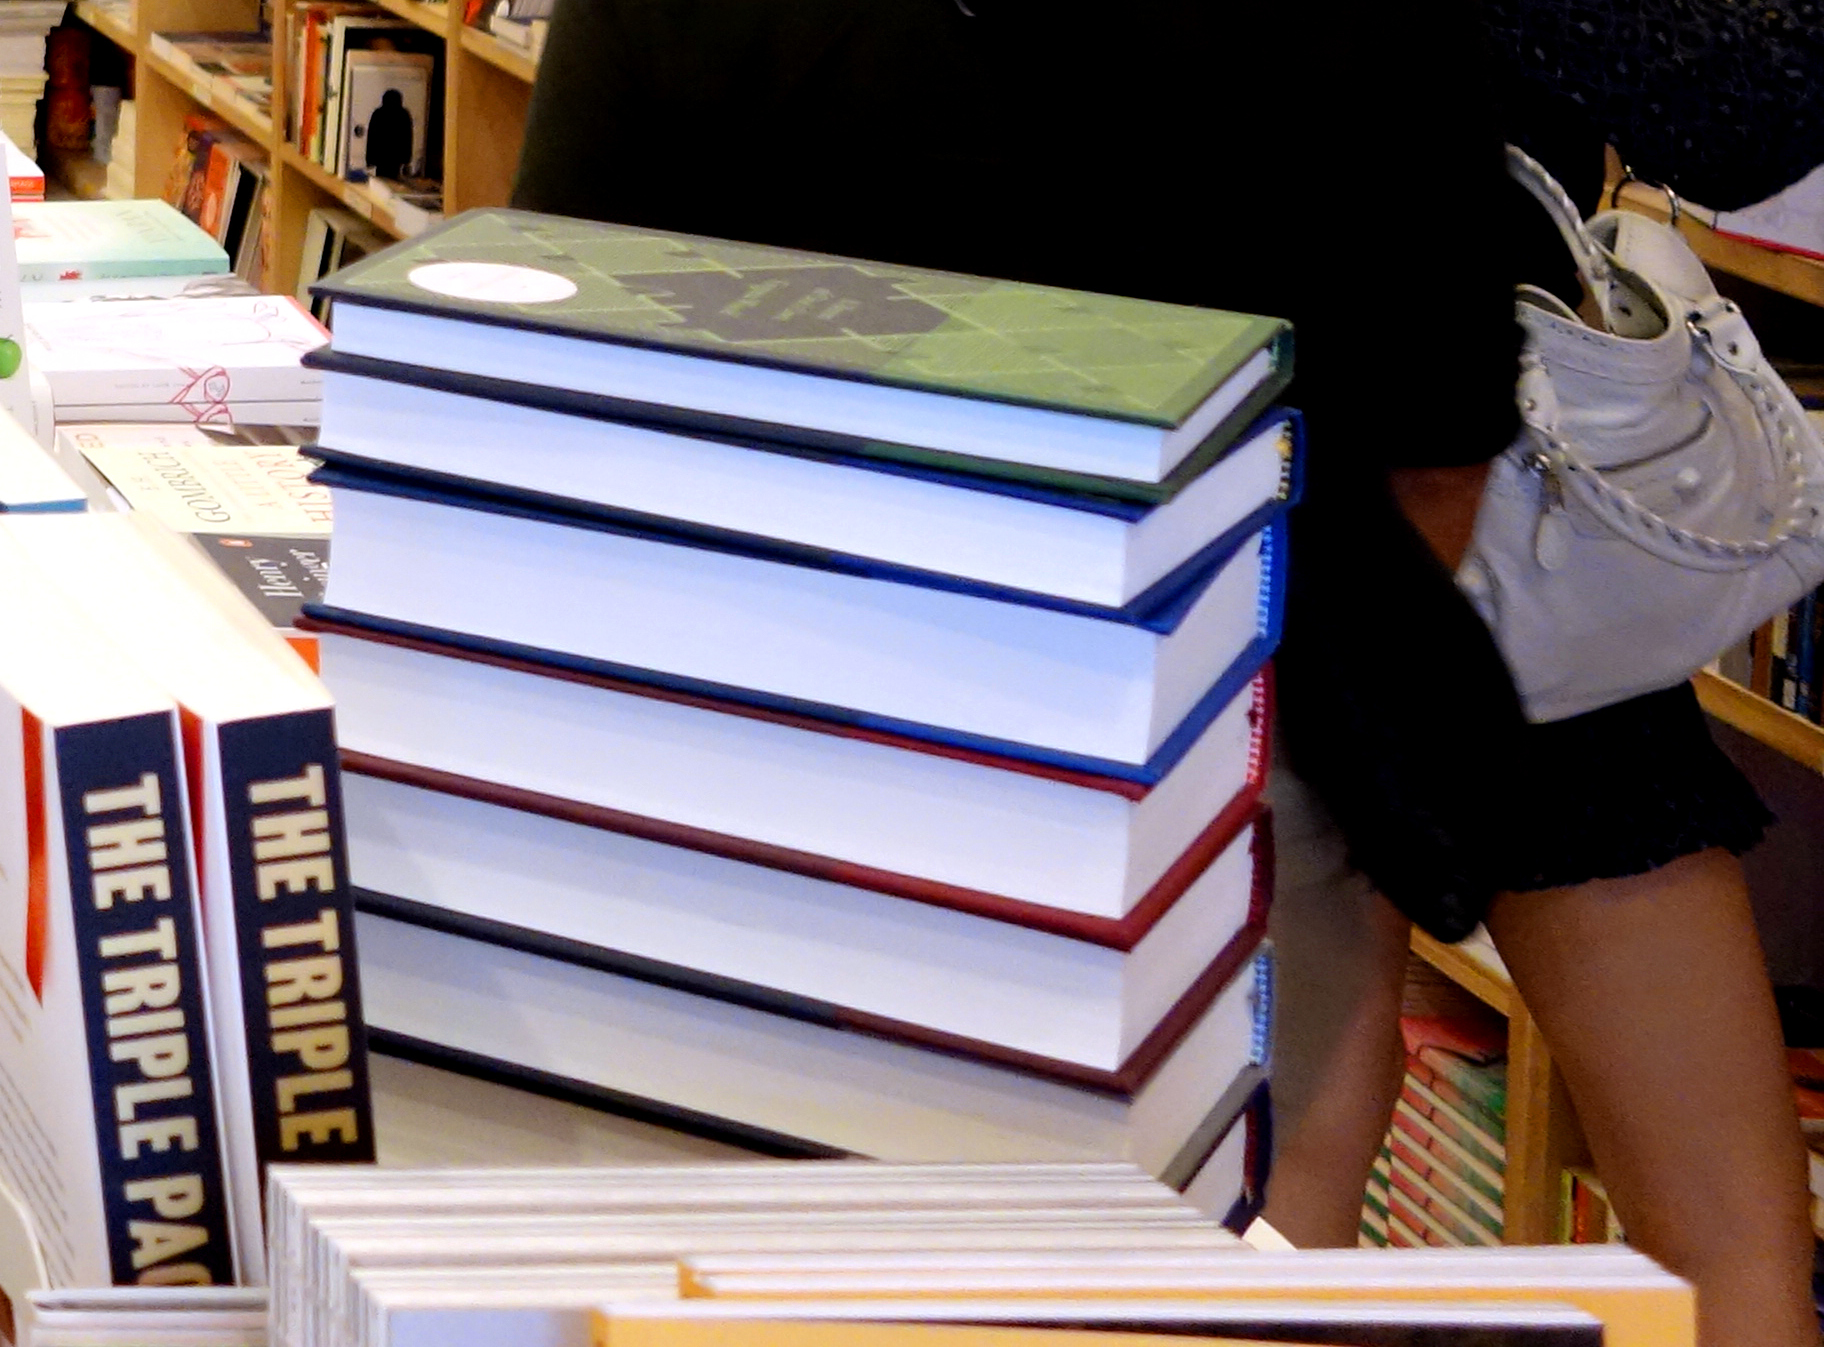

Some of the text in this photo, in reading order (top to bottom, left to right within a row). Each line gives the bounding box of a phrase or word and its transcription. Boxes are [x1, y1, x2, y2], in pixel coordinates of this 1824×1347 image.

[138, 451, 231, 524] GOMBRICH
[248, 451, 333, 523] HISTORY
[245, 556, 303, 598] Henry
[83, 772, 174, 911] THE
[248, 763, 359, 1152] THE TRIPLE
[98, 916, 201, 1160] TRIPLE
